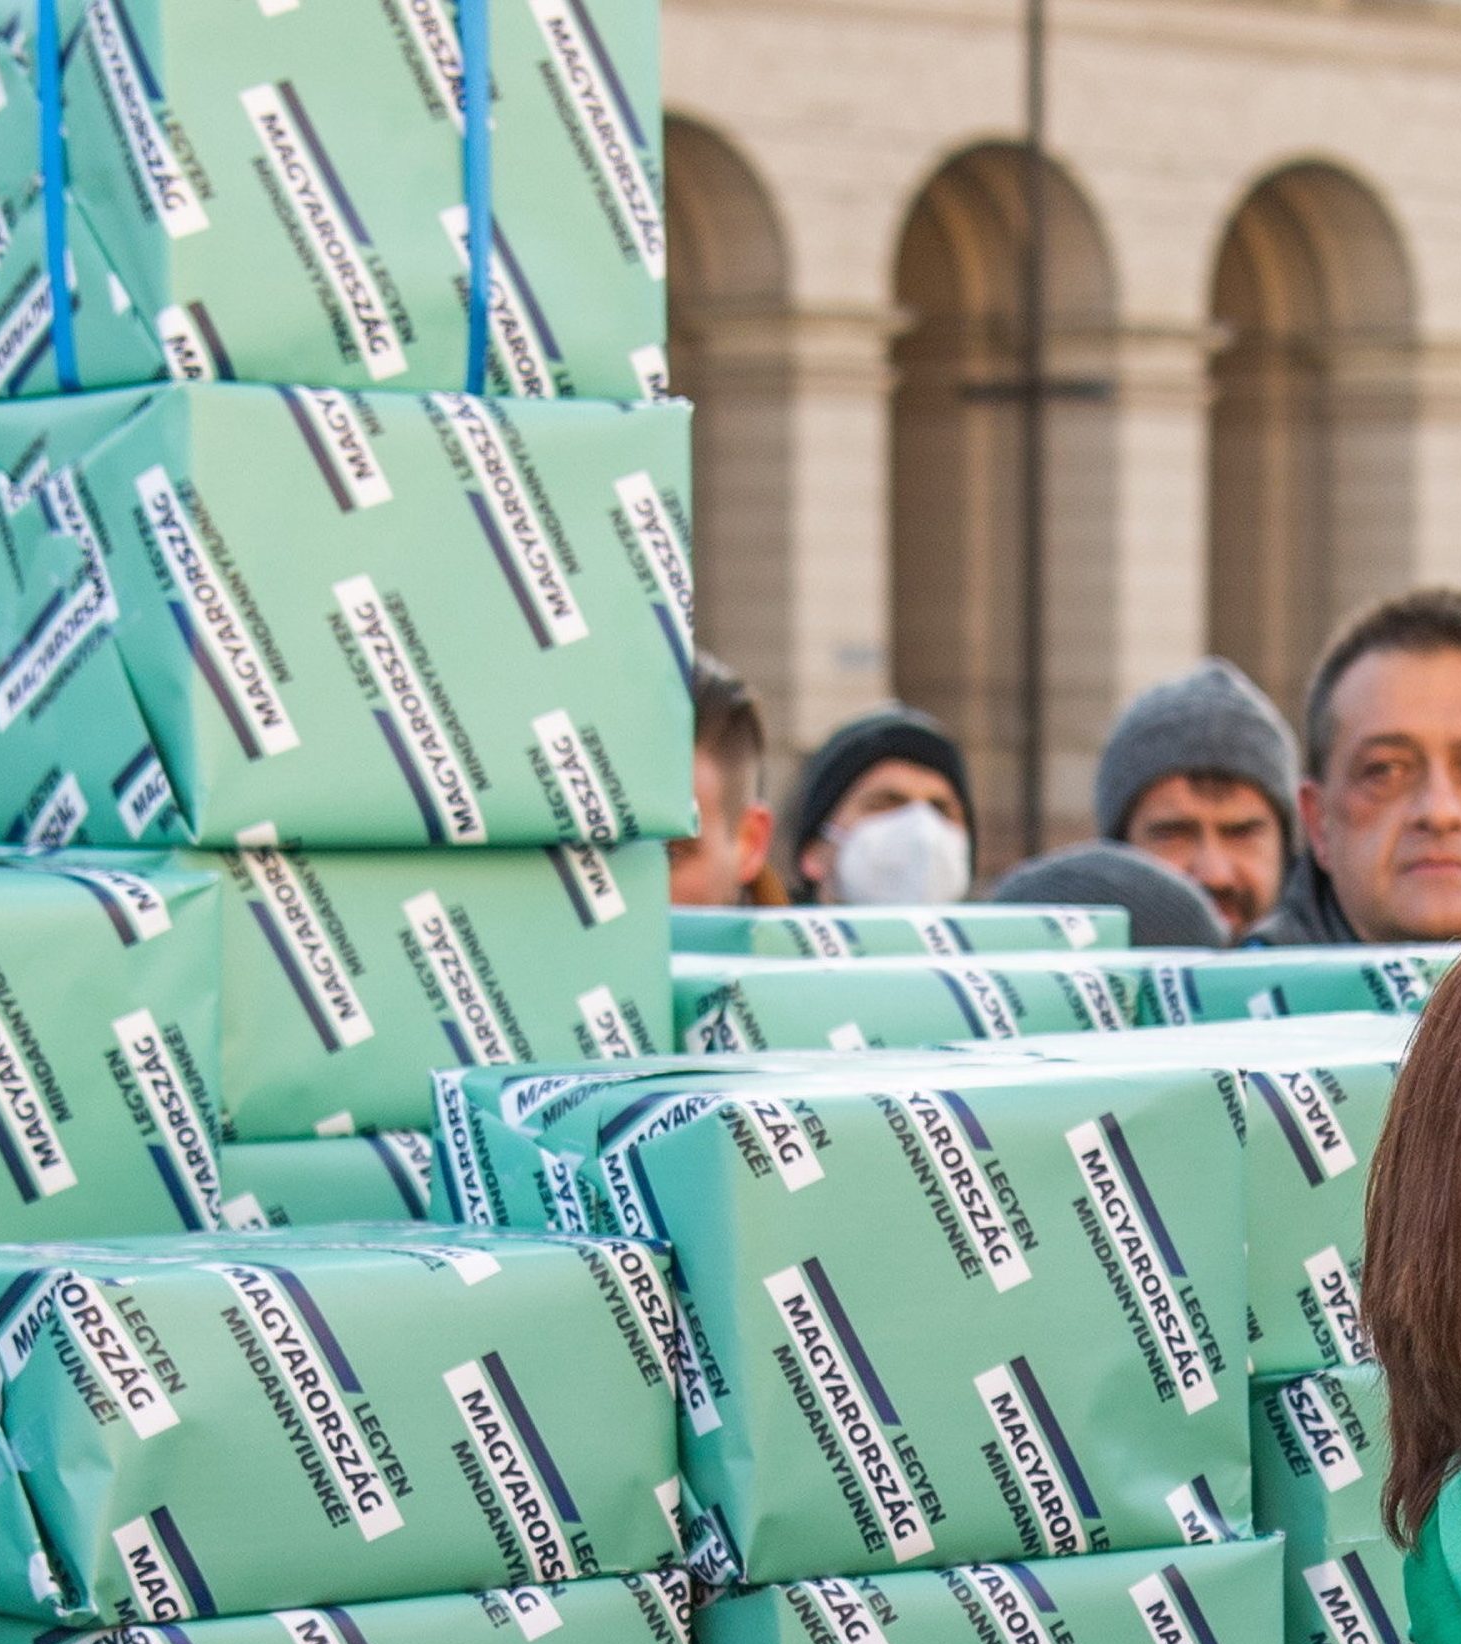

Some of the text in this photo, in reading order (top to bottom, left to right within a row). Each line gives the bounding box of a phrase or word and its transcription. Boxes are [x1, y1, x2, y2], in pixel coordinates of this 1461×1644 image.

[399, 929, 446, 1013] LEGYEN
[104, 1047, 153, 1138] LEGYEN
[985, 1160, 1038, 1250] LEGYEN
[1073, 1197, 1176, 1403] MINDANNYIUNKÉ!
[1081, 1149, 1202, 1390] MAGYARORSZÁG
[114, 1297, 188, 1396] LEGYEN
[685, 1303, 730, 1400] LEGYEN
[1178, 1285, 1226, 1375] LEGYEN
[220, 1306, 350, 1529] MINDANNYIUNKÉ!
[223, 1266, 384, 1513] MAGYARORSZÁG
[784, 1295, 917, 1541] MAGYARORSZÁG
[353, 1401, 412, 1497] LEGYEN
[772, 1345, 886, 1554] MINDANNYIUNKÉ!
[892, 1435, 946, 1524] LEGYEN
